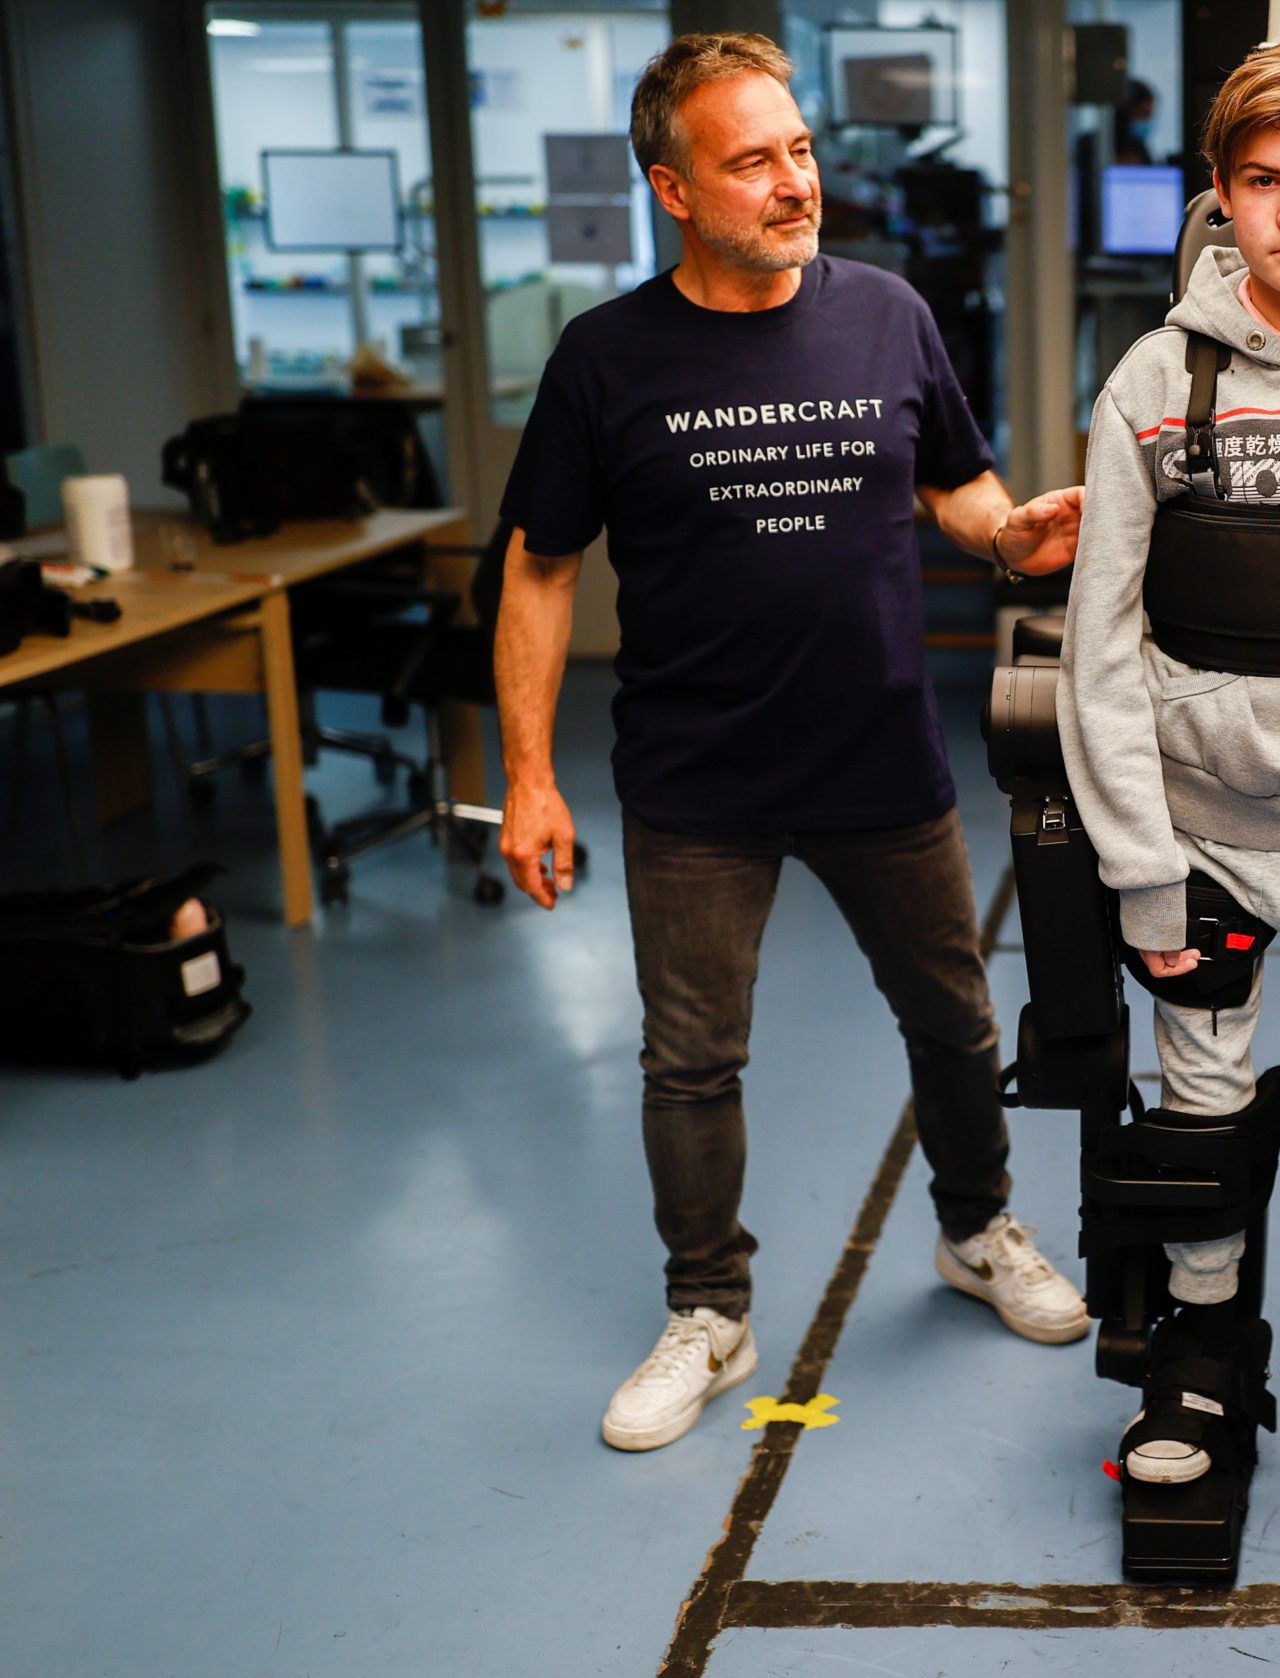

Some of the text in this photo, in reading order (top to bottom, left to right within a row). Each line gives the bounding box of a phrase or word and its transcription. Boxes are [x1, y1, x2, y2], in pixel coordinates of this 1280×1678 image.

[665, 398, 883, 433] WANDERCRAFT
[689, 440, 876, 468] ORDINARY LIFE FOR
[709, 476, 864, 502] EXTRAORDINARY
[756, 514, 826, 534] PEOPLE
